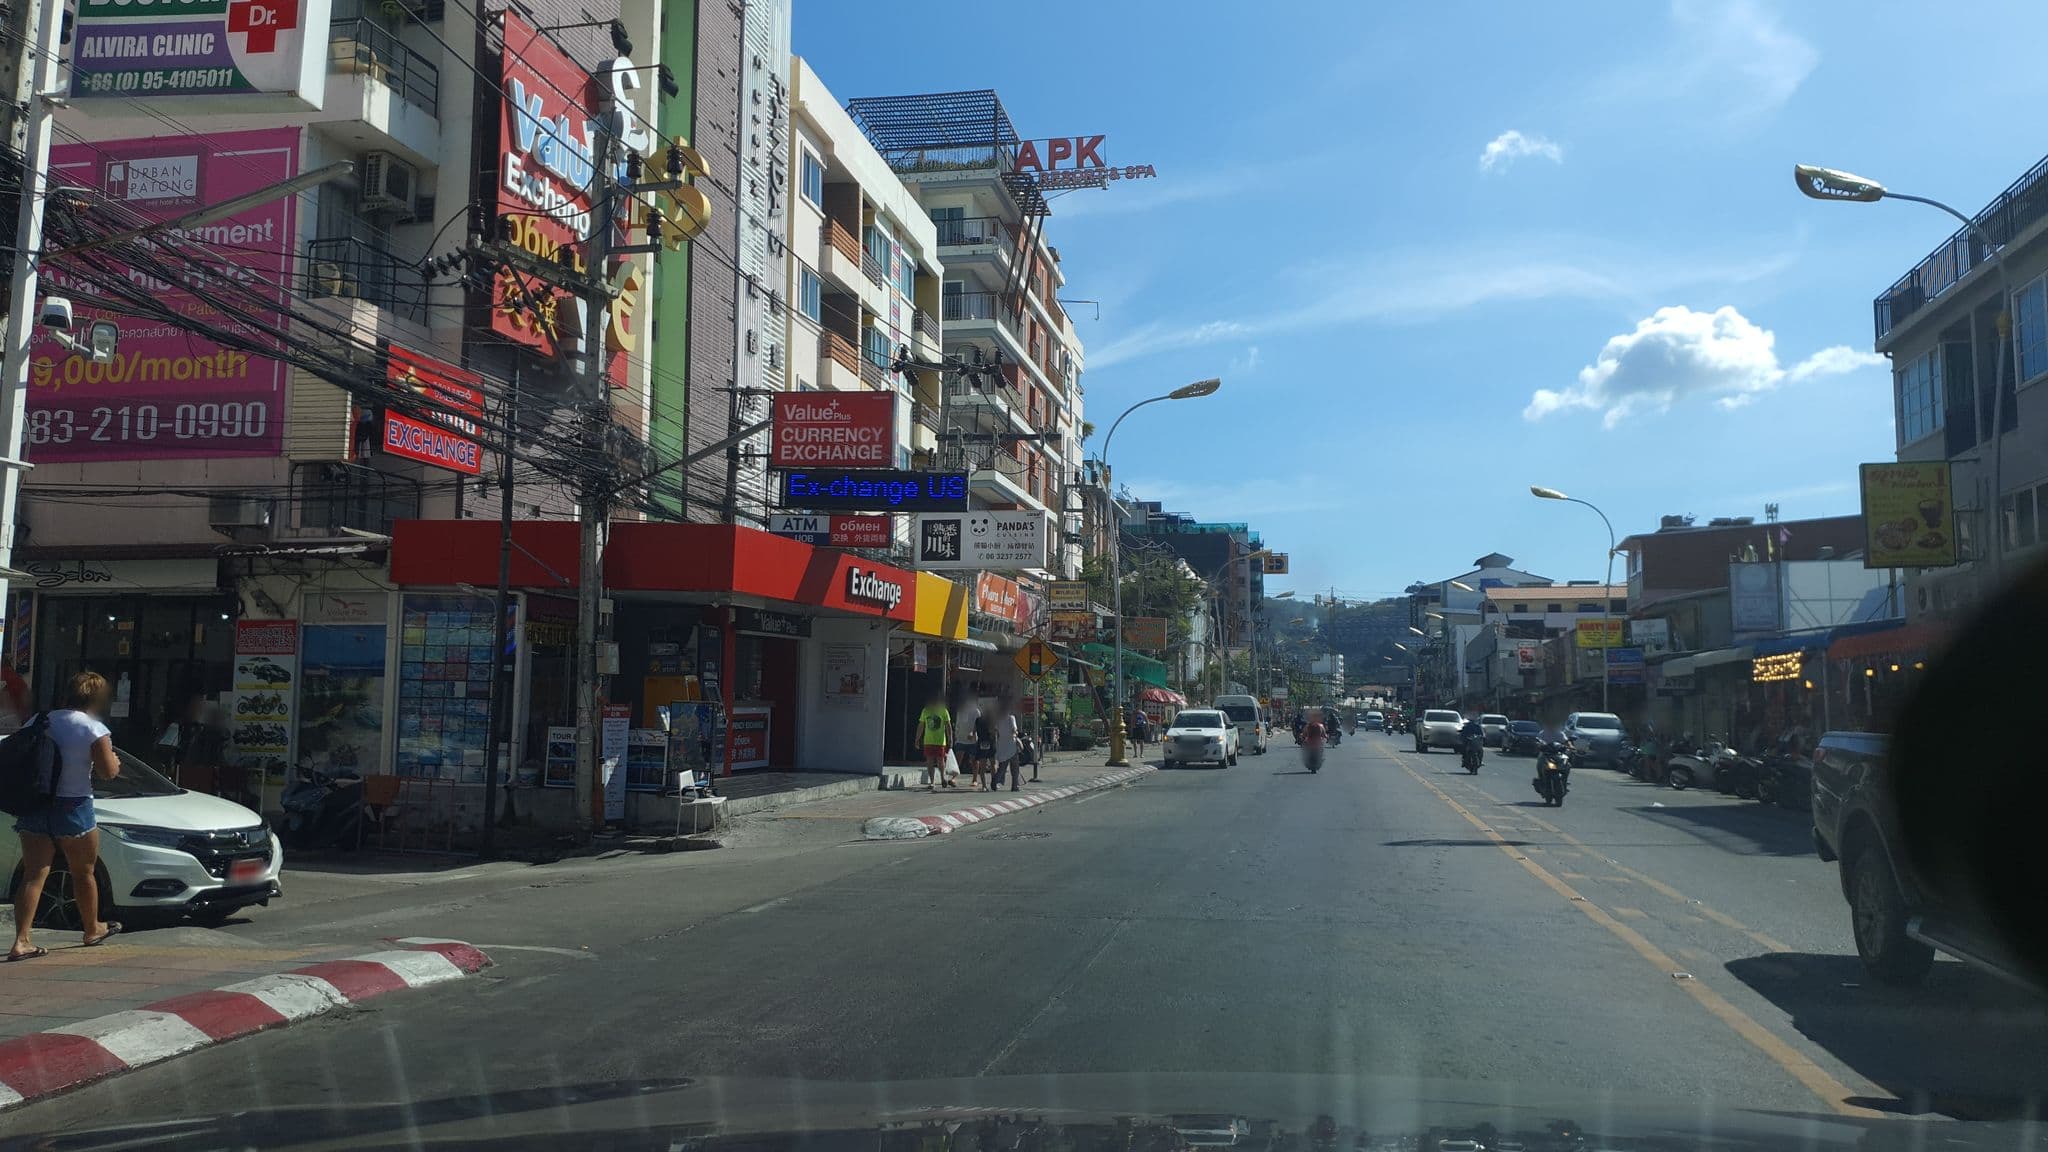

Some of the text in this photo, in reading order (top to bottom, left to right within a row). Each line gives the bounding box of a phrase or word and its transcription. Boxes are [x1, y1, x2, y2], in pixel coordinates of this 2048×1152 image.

[249, 4, 277, 26] Dr.
[81, 33, 214, 58] ALVIRA CLINIC
[115, 74, 138, 90] (0)
[142, 69, 233, 88] 95-4105011
[509, 77, 600, 197] Valu
[1014, 135, 1106, 172] APK
[131, 165, 182, 180] URBAN
[1038, 164, 1157, 188] RESORT & SPA
[130, 179, 194, 193] PATONG
[504, 151, 592, 243] Exchang
[22, 401, 267, 446] 83-210-0990
[387, 418, 478, 468] EXCHANGE
[781, 426, 884, 443] CURRENCY
[780, 444, 883, 461] EXCHANGE
[789, 473, 919, 504] Ex-change
[782, 517, 818, 531] ATM
[839, 520, 880, 532] обмен
[996, 521, 1035, 531] PANDA'S
[794, 534, 814, 543] UOB
[851, 566, 902, 610] Exchange
[552, 732, 571, 743] TOUR
